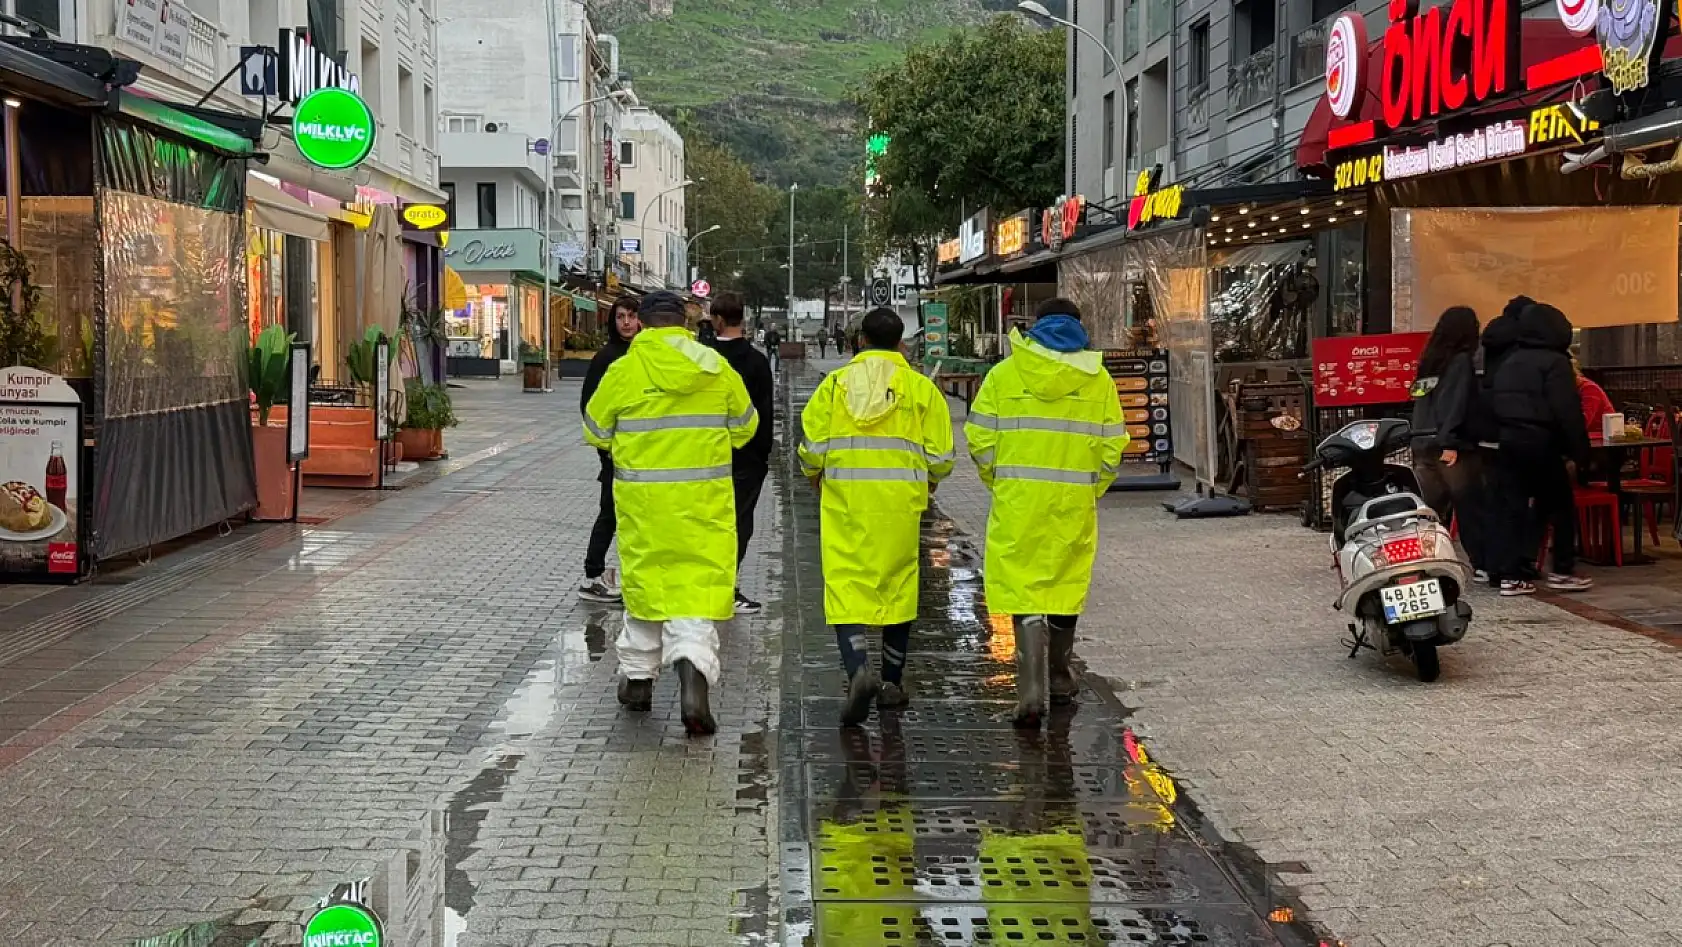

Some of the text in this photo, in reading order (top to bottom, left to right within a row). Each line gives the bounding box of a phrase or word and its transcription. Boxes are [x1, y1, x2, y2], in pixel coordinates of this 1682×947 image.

[1334, 154, 1382, 192] 502 00 42
[408, 210, 441, 220] gratis
[8, 373, 53, 387] Kumpir
[0, 385, 38, 399] ünyası
[1408, 582, 1437, 599] AZC
[1399, 597, 1429, 614] 265
